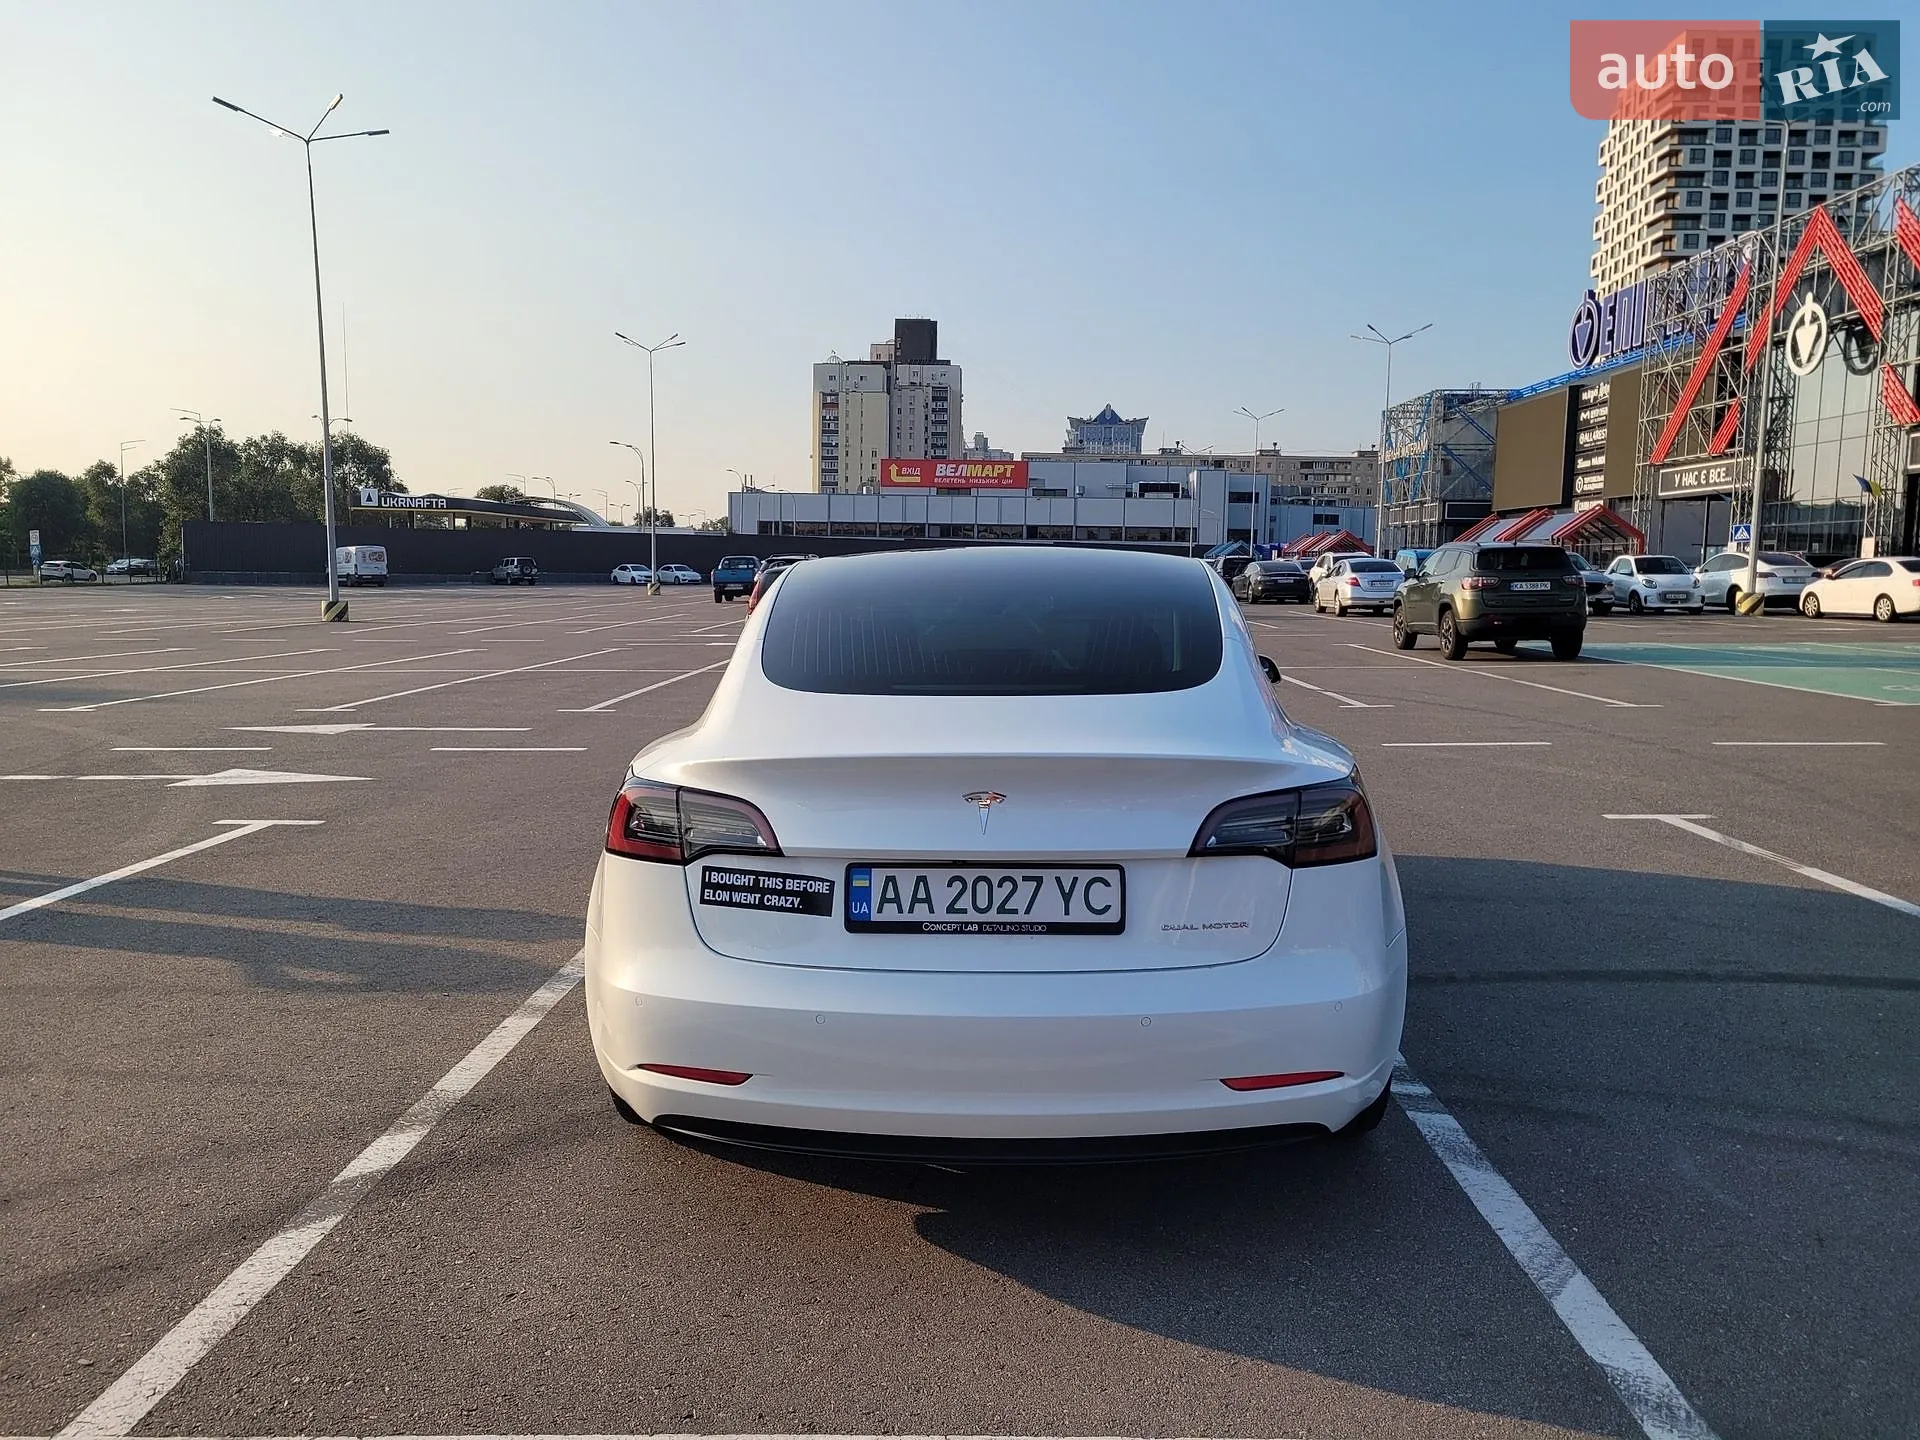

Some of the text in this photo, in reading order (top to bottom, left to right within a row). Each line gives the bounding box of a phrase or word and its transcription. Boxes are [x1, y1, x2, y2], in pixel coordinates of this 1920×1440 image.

[901, 467, 921, 475] ВХІД
[935, 463, 1015, 477] ВЕЛМАРТ
[1674, 467, 1732, 488] У НАС Є ВСЕ...
[381, 497, 447, 508] UKRNAFTA
[705, 871, 831, 893] I BOUGHT THIS BEFORE
[704, 889, 803, 909] ELON WENT CRAZY.
[876, 875, 1112, 916] AA 2027 YC
[852, 902, 869, 914] UA
[962, 923, 979, 931] LAB
[1021, 924, 1047, 932] STUDIO
[1202, 921, 1249, 930] MOTOR
